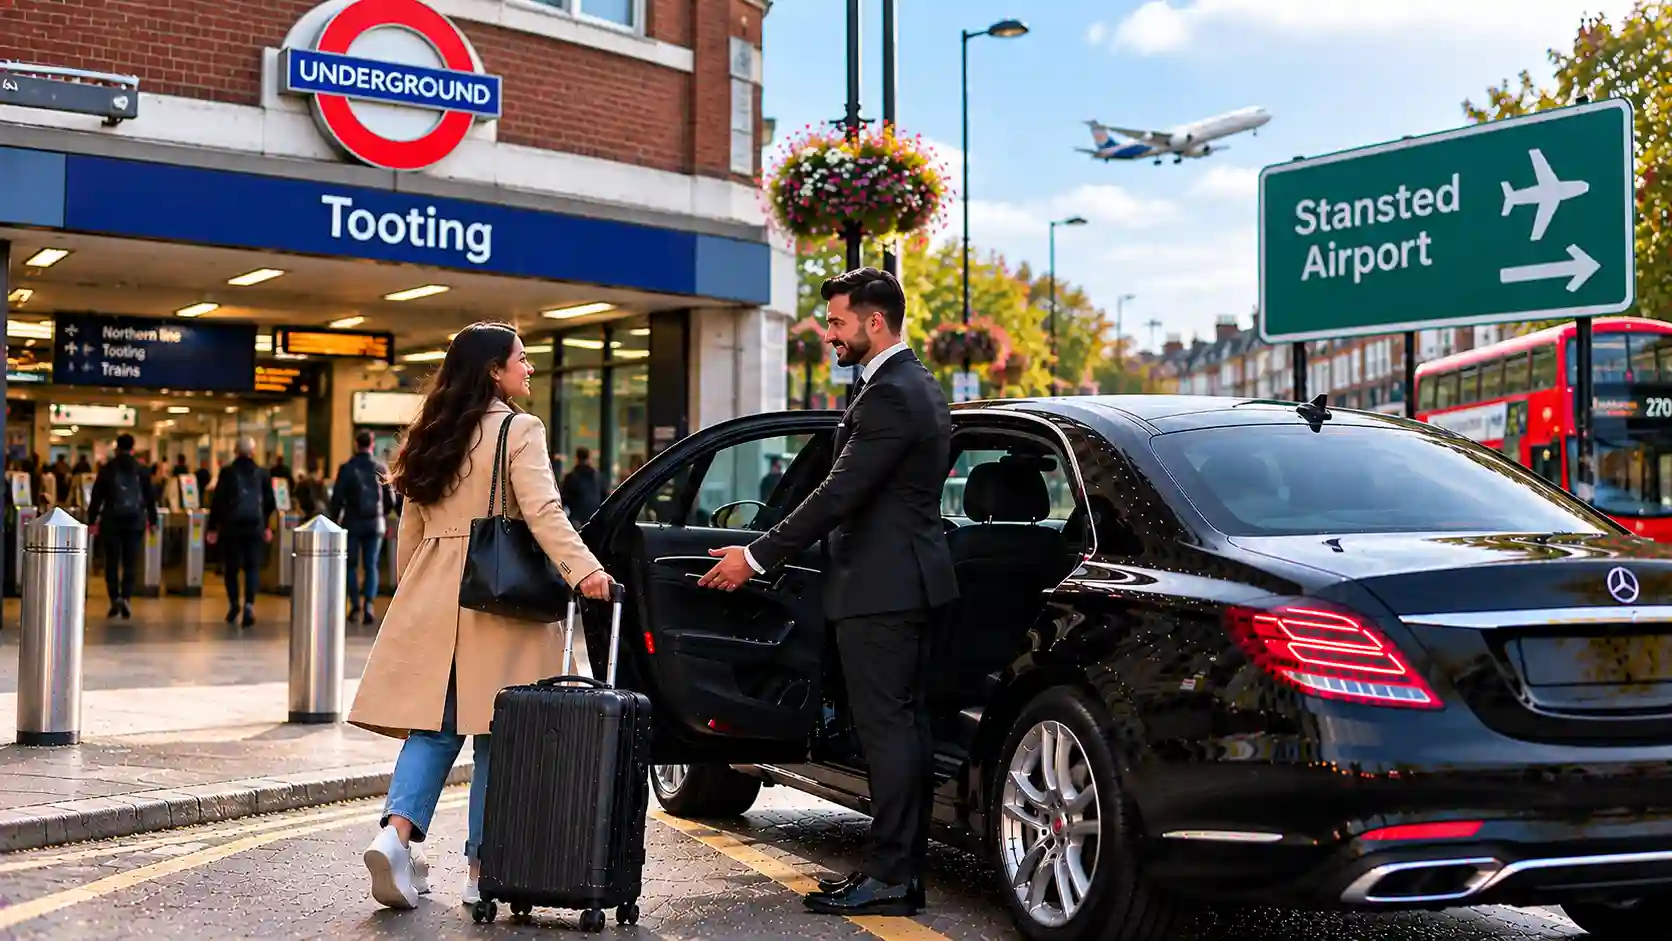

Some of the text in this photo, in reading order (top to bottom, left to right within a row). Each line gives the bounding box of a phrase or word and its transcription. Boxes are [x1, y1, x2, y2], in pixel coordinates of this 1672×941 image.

[300, 59, 491, 105] UNDERGROUND
[1294, 172, 1460, 236] Stansted
[321, 194, 493, 264] Tooting
[1300, 230, 1433, 284] Airport
[102, 325, 157, 342] Northern
[101, 361, 141, 378] Trains
[102, 345, 146, 361] Tooting
[1645, 397, 1672, 418] 270
